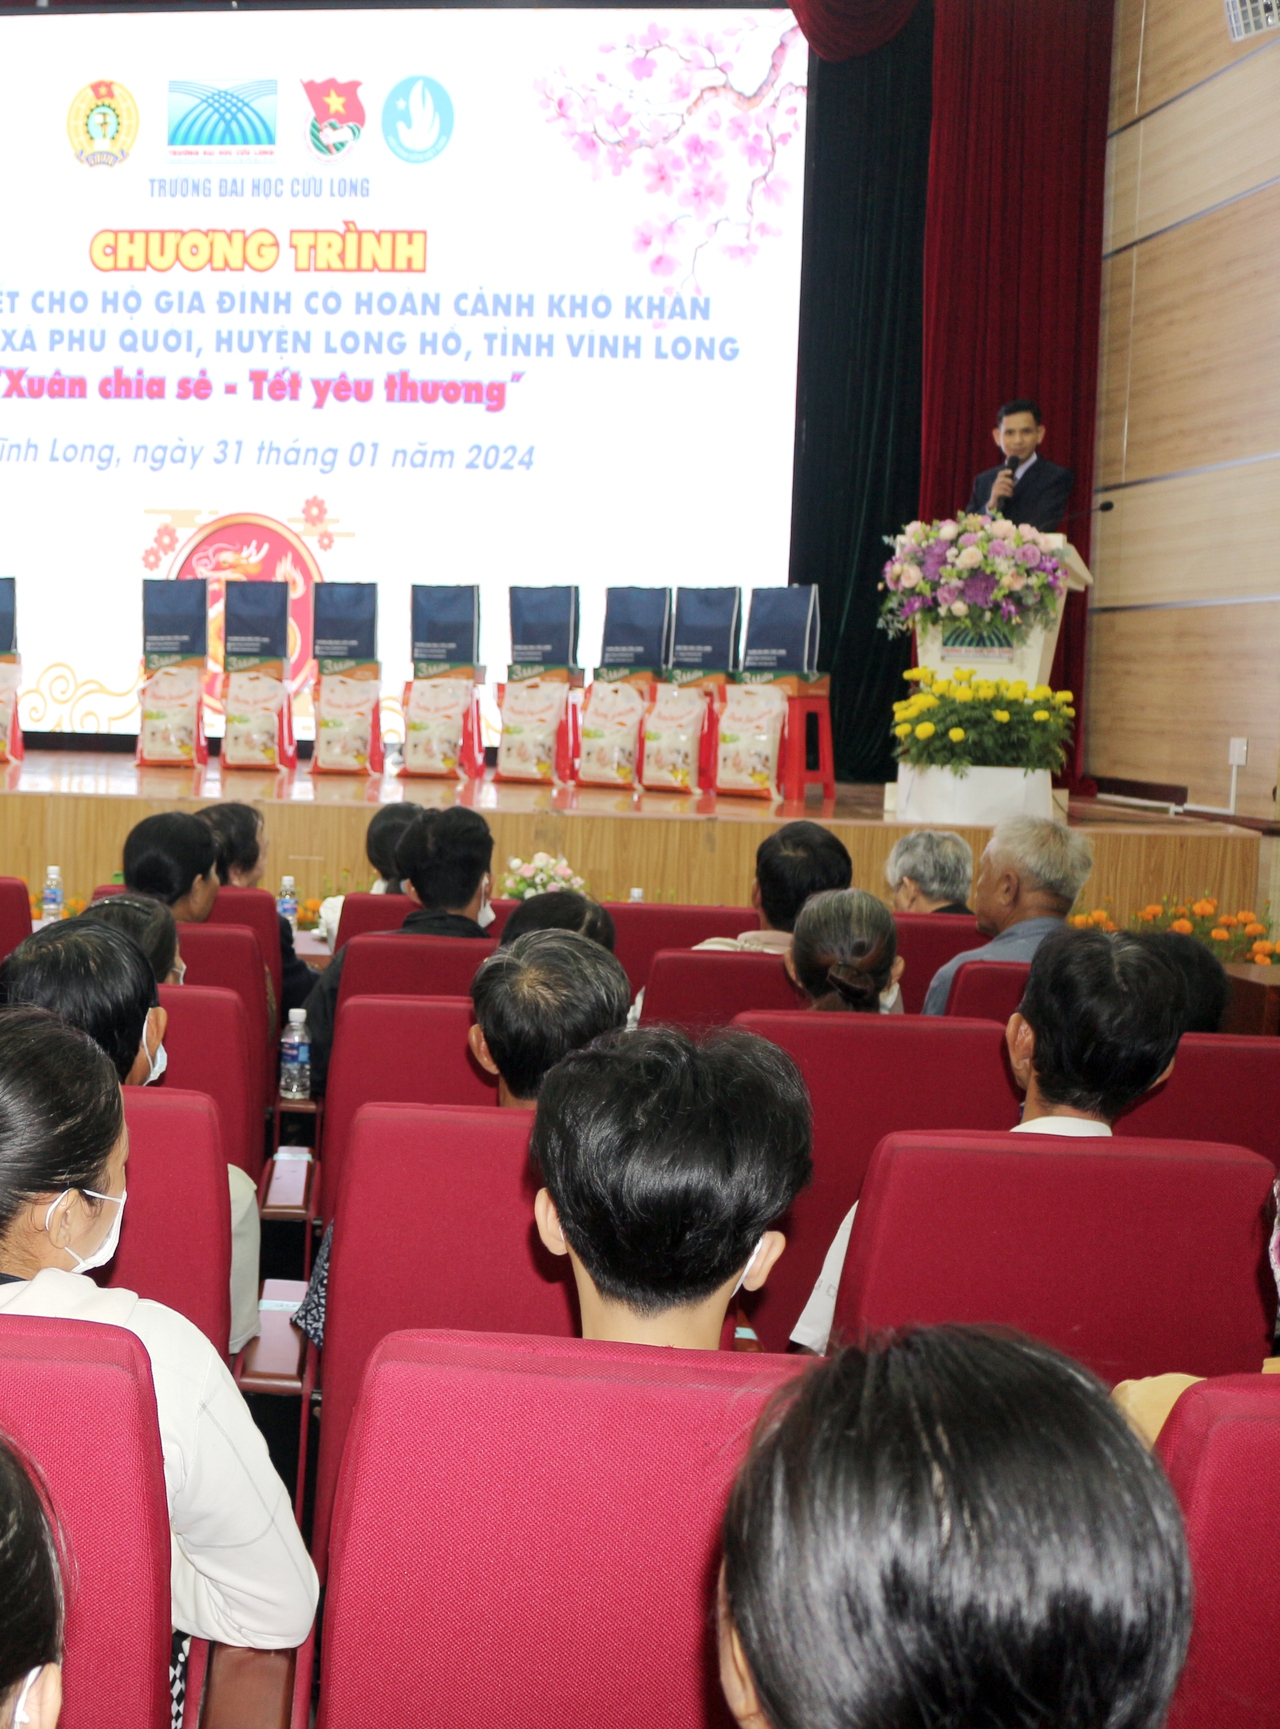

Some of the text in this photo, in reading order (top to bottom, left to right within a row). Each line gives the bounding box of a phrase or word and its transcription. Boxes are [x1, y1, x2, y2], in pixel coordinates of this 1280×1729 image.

[149, 172, 369, 200] TRƯỜNG ĐẠI HỌC CỬU LONG
[89, 220, 427, 273] CHƯƠNG TRÌNH
[31, 290, 88, 313] CHO
[102, 285, 142, 320] HỘ
[155, 290, 205, 313] GIA
[216, 284, 291, 314] ĐÌNH
[305, 285, 342, 315] CÓ
[355, 286, 440, 315] HOÀN
[454, 286, 534, 317] CẢNH
[548, 288, 612, 319] KHÓ
[625, 291, 710, 320] KHĂN
[0, 325, 37, 351] XÃ
[49, 323, 106, 352] PHÚ
[216, 325, 311, 359] HUYỆN
[325, 330, 407, 355] LONG
[420, 324, 472, 361] HỒ,
[484, 326, 554, 357] TỈNH
[566, 329, 641, 359] VĨNH
[655, 336, 740, 361] LONG
[98, 366, 166, 400] chia
[175, 368, 213, 401] sẻ
[224, 382, 237, 395] -
[249, 366, 302, 402] Tết
[310, 371, 374, 409] yêu
[50, 438, 120, 470] Long,
[134, 437, 204, 471] ngày
[214, 439, 243, 464] 31
[257, 438, 338, 474] tháng
[349, 442, 379, 466] 01
[392, 442, 454, 468] năm
[465, 444, 535, 470] 2024
